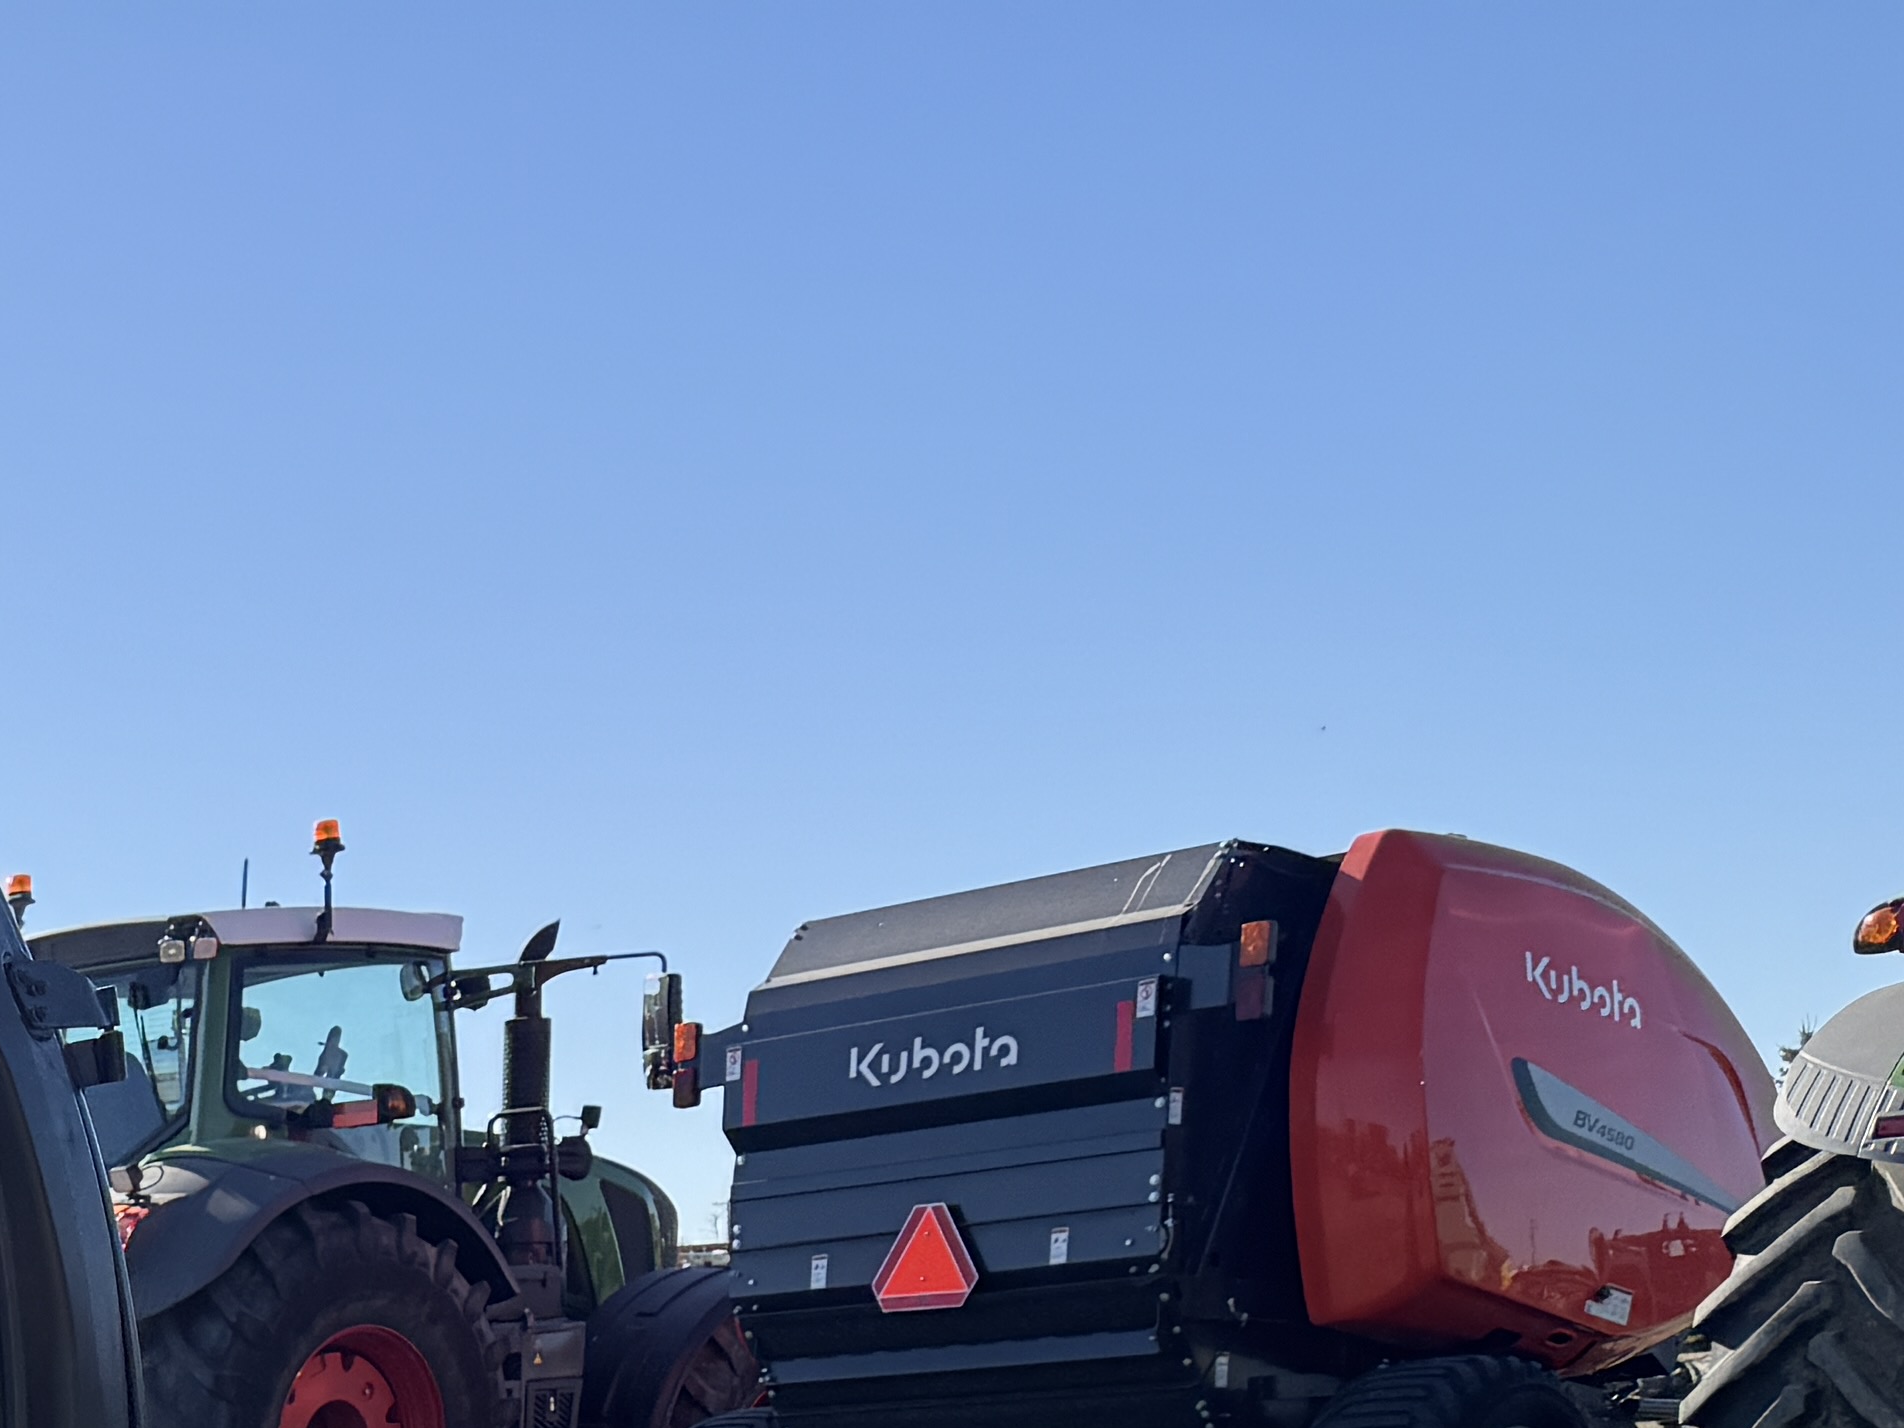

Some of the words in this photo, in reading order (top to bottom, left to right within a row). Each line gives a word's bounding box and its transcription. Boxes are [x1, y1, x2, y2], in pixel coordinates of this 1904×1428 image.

[1525, 951, 1641, 1029] Kubota
[848, 1026, 1019, 1087] Kubota
[1573, 1110, 1635, 1151] BV4580
